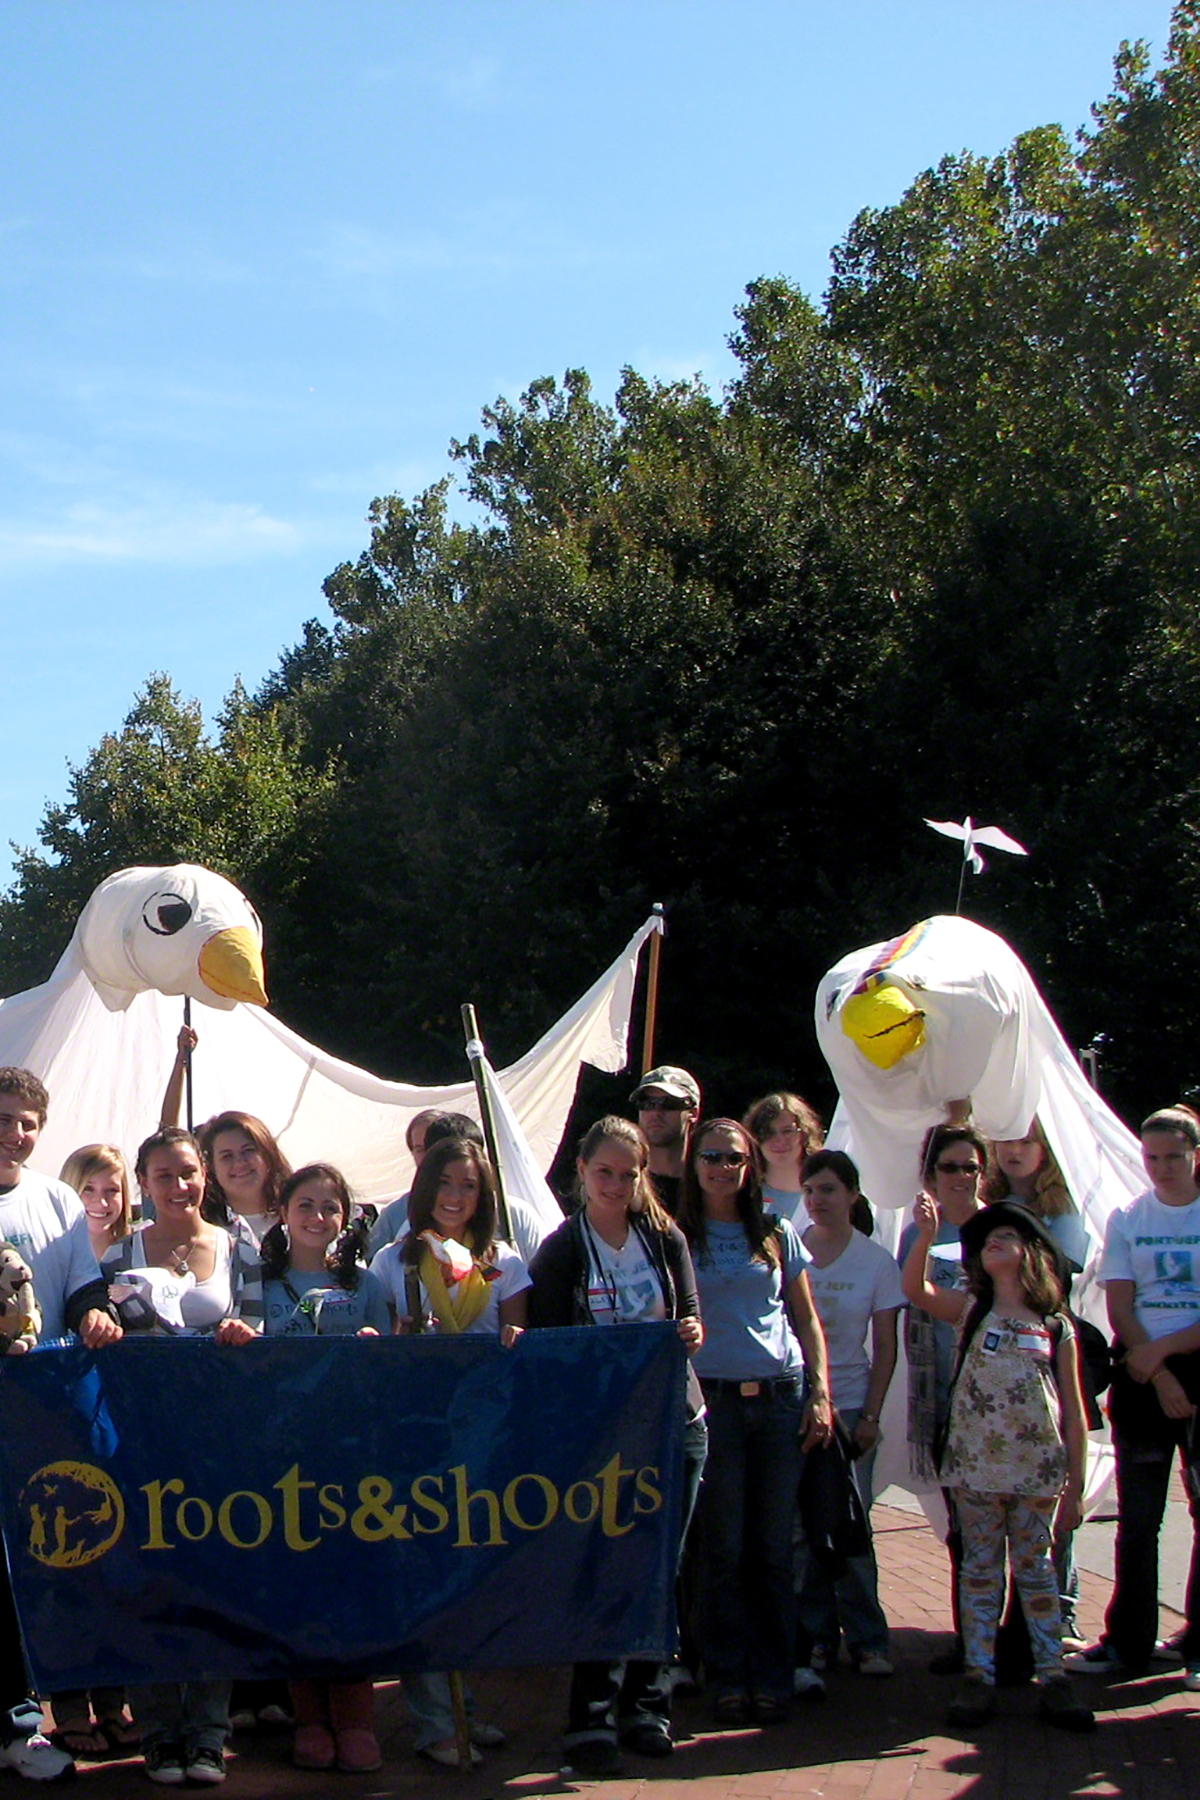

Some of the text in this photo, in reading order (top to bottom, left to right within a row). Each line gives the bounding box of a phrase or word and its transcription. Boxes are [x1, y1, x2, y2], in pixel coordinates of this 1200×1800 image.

[1135, 1235, 1200, 1246] PORT JEF
[140, 1451, 662, 1552] roots&shoots
